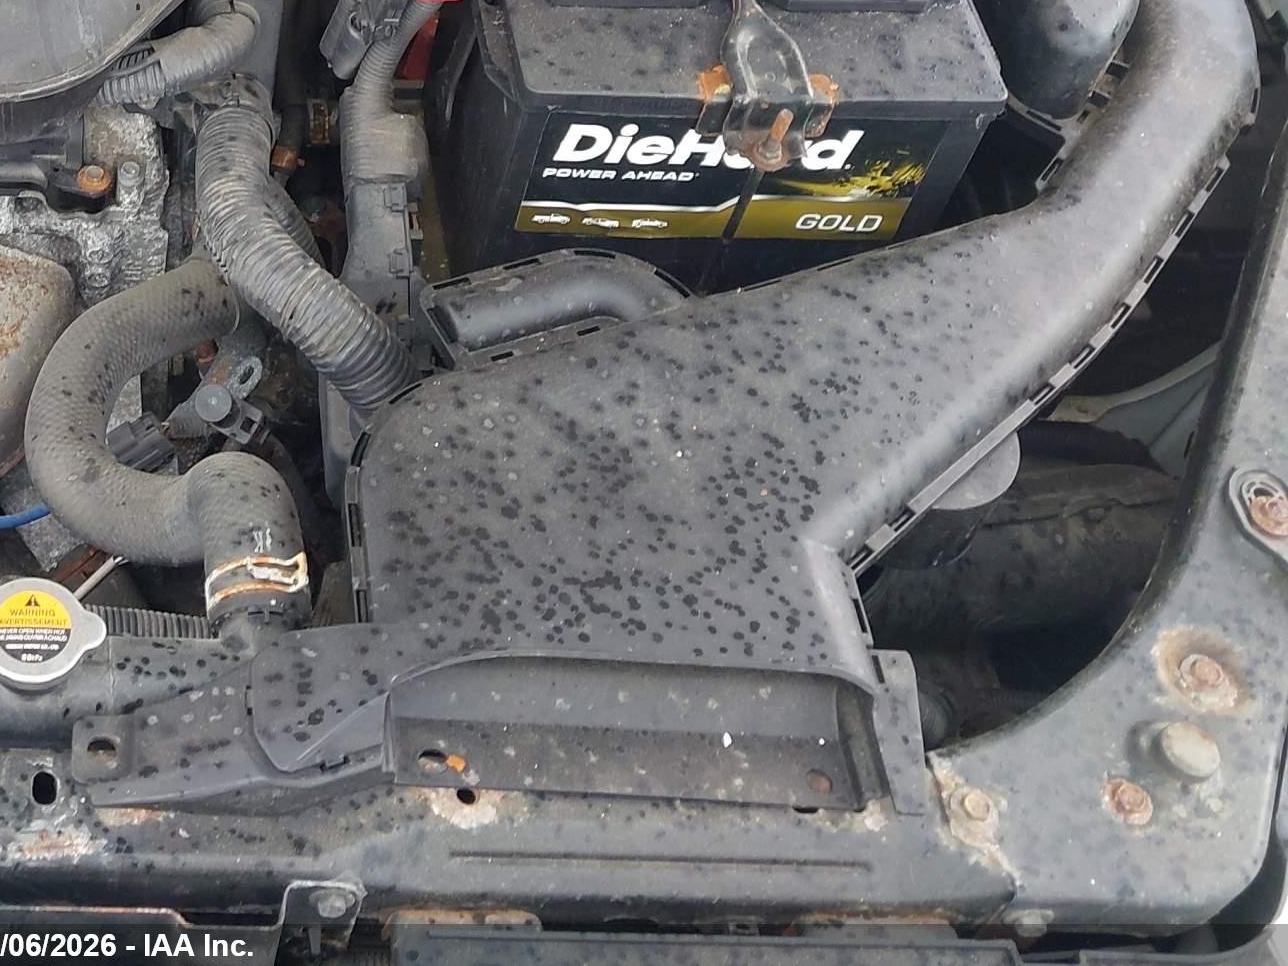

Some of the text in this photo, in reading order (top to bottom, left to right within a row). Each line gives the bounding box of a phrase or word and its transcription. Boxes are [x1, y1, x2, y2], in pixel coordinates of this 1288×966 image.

[552, 124, 865, 170] DieHd
[542, 168, 696, 182] POWER AHEAD
[796, 214, 884, 232] GOLD
[10, 609, 56, 617] WARNING
[0, 617, 67, 626] AVERTISSEMENT
